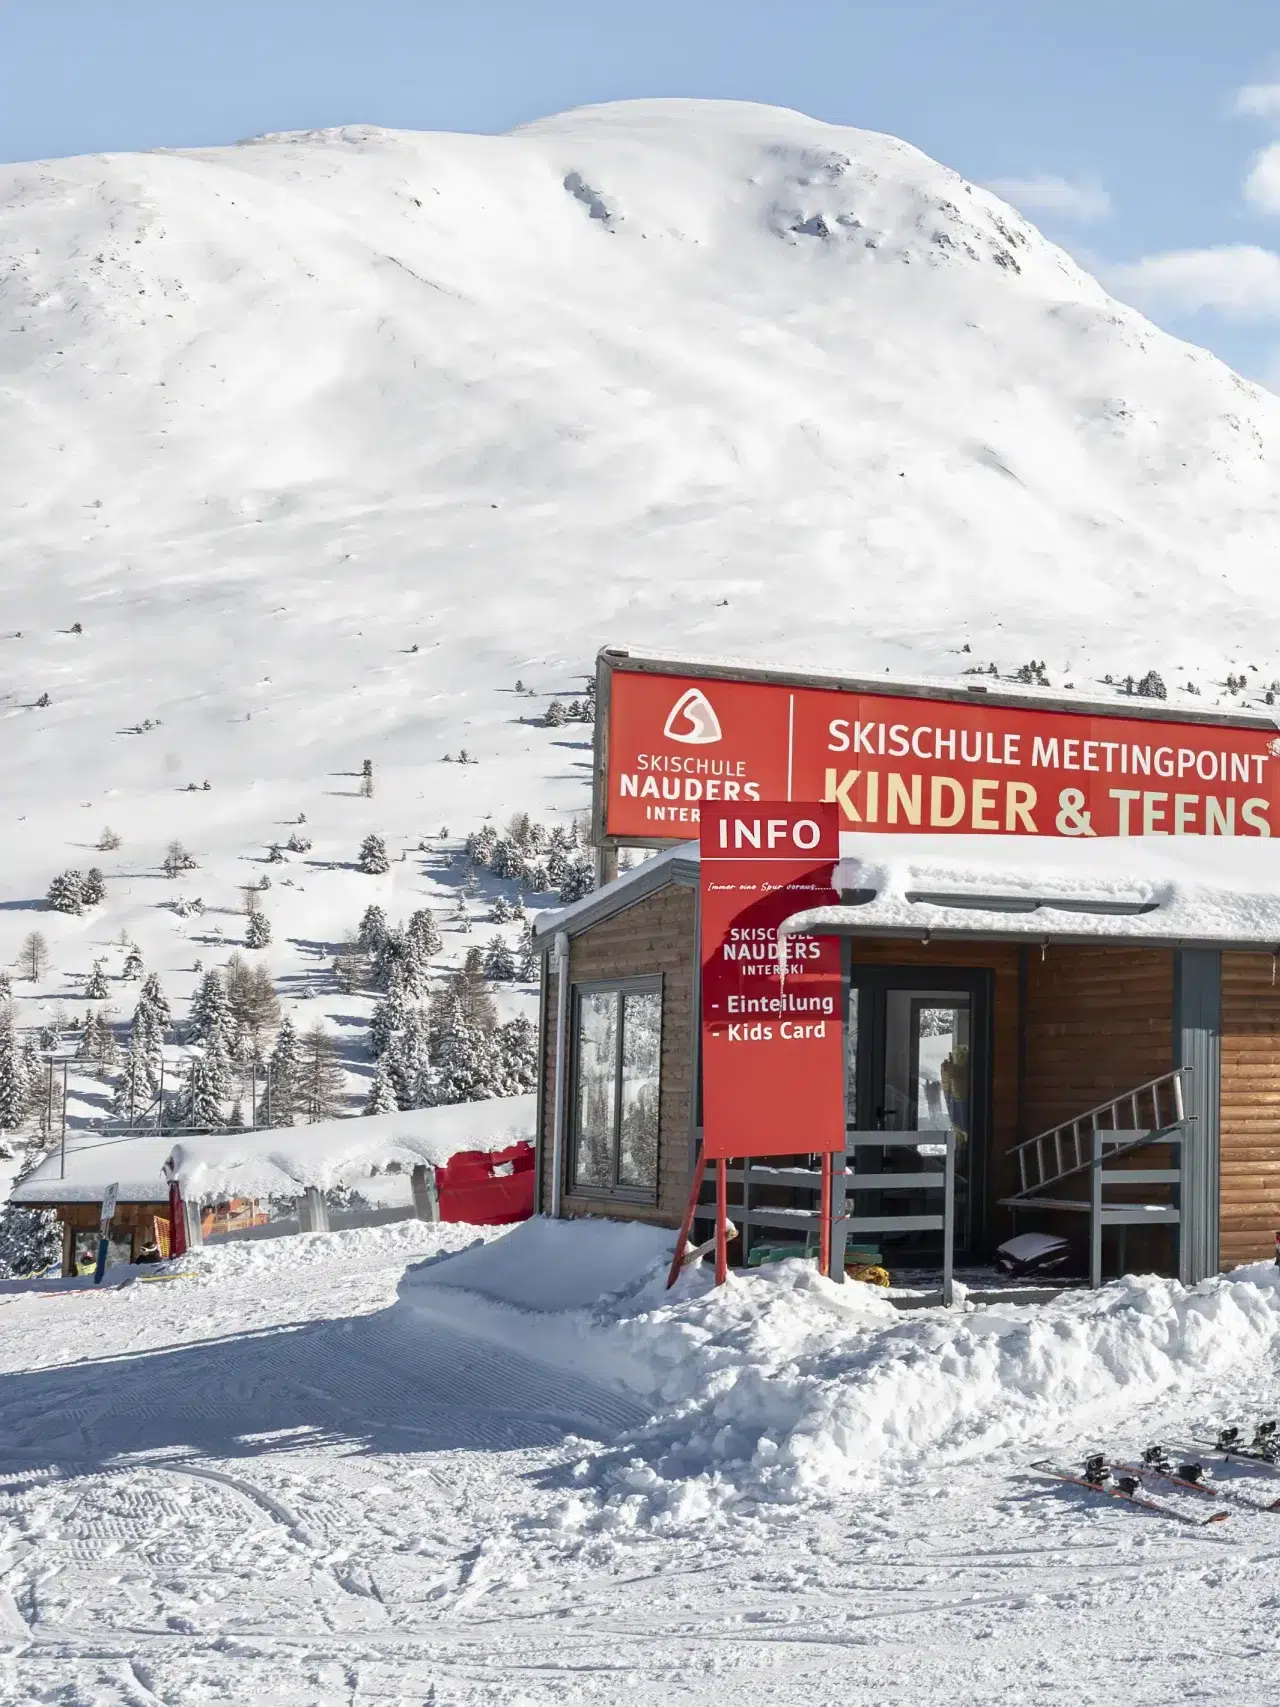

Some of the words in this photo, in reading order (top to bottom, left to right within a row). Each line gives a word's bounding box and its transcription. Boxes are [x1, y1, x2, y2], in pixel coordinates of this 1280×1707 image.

[828, 719, 1021, 765] SKISCHULE
[1031, 736, 1269, 784] MEETINGPOINT
[637, 753, 746, 777] SKISCHULE
[620, 773, 760, 802] NAUDERS
[646, 805, 701, 823] INTER
[825, 768, 1039, 832] KINDER
[1055, 787, 1097, 837] &
[1109, 788, 1271, 838] TEENS
[719, 818, 821, 849] INFO
[707, 882, 736, 892] Immer
[761, 881, 783, 892] Spur
[723, 942, 821, 960] NAUDERS
[728, 995, 833, 1014] Einteilung
[728, 1022, 773, 1041] Kids
[780, 1021, 826, 1039] Card
